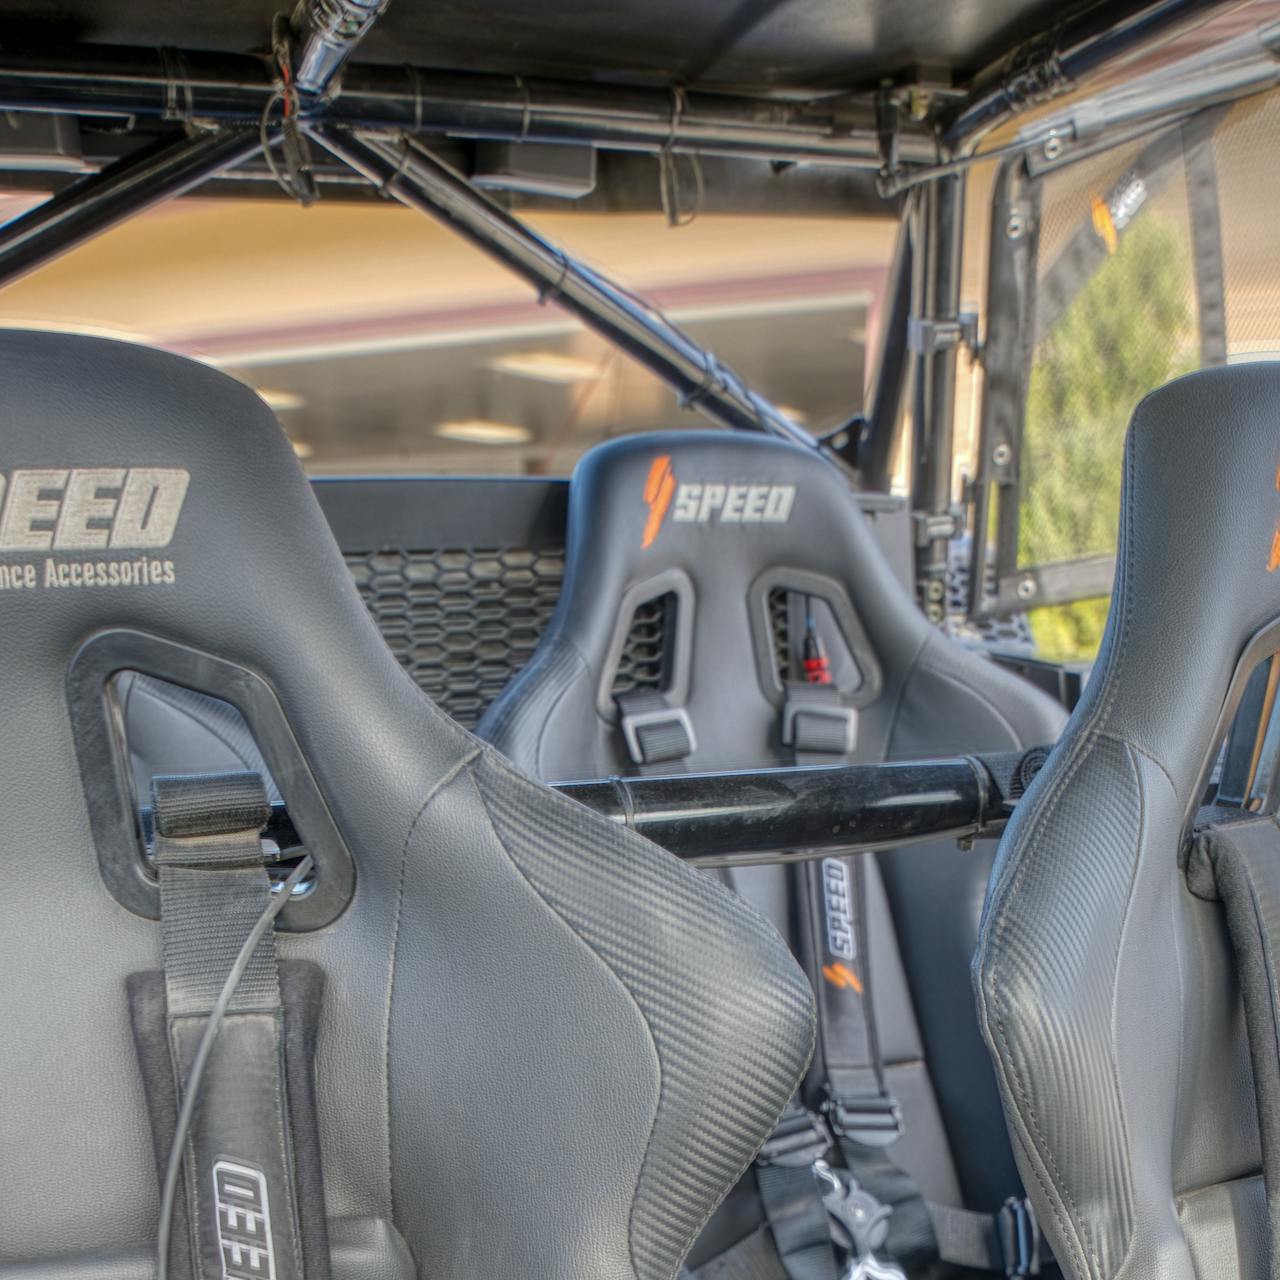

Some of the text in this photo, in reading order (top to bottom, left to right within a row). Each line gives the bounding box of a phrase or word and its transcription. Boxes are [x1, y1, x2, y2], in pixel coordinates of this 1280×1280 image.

[672, 484, 796, 523] SPEED
[44, 557, 176, 589] Accessories
[822, 857, 857, 961] SPEED
